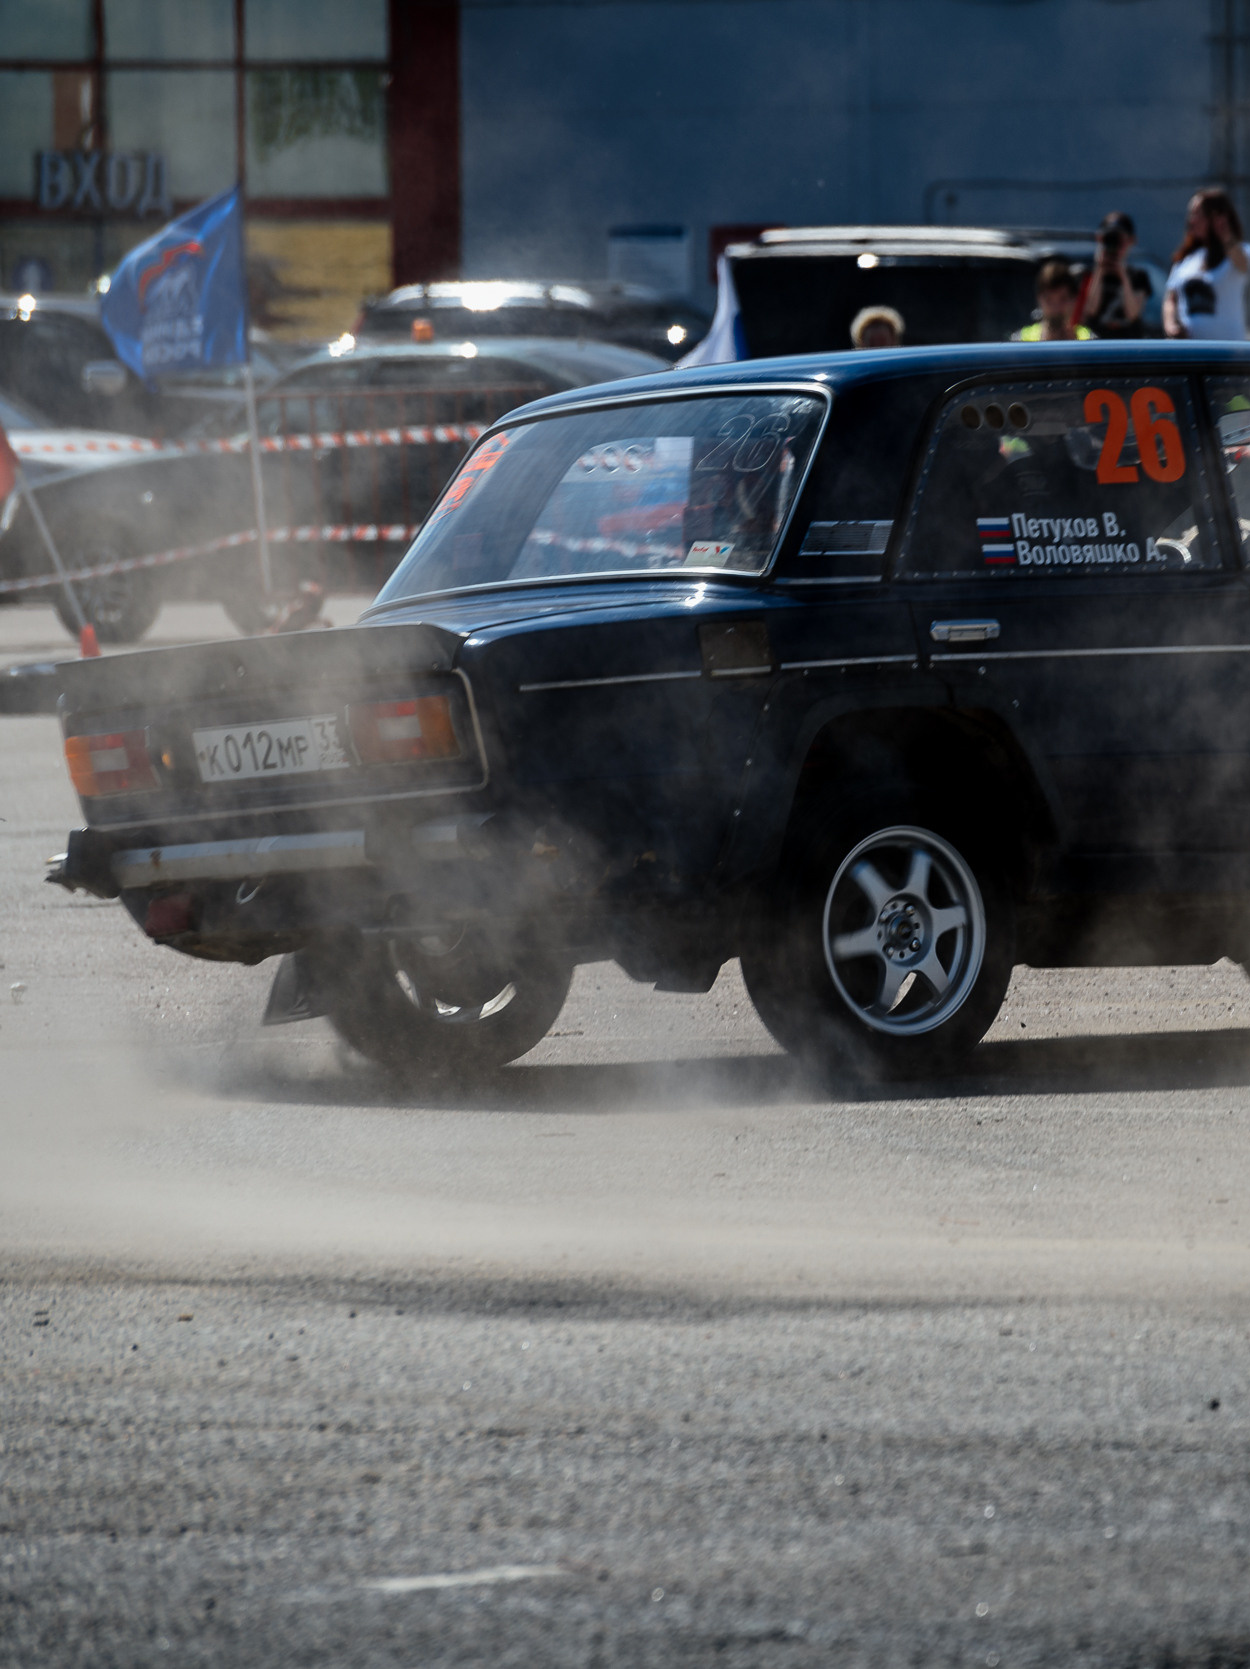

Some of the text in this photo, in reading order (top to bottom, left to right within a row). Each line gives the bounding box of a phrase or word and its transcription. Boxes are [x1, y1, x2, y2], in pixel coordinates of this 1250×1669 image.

[37, 152, 172, 218] ВХОД
[694, 413, 791, 472] 26
[1084, 387, 1186, 484] 26
[1011, 512, 1127, 543] Петухов В.
[1016, 540, 1140, 565] Воловяшко
